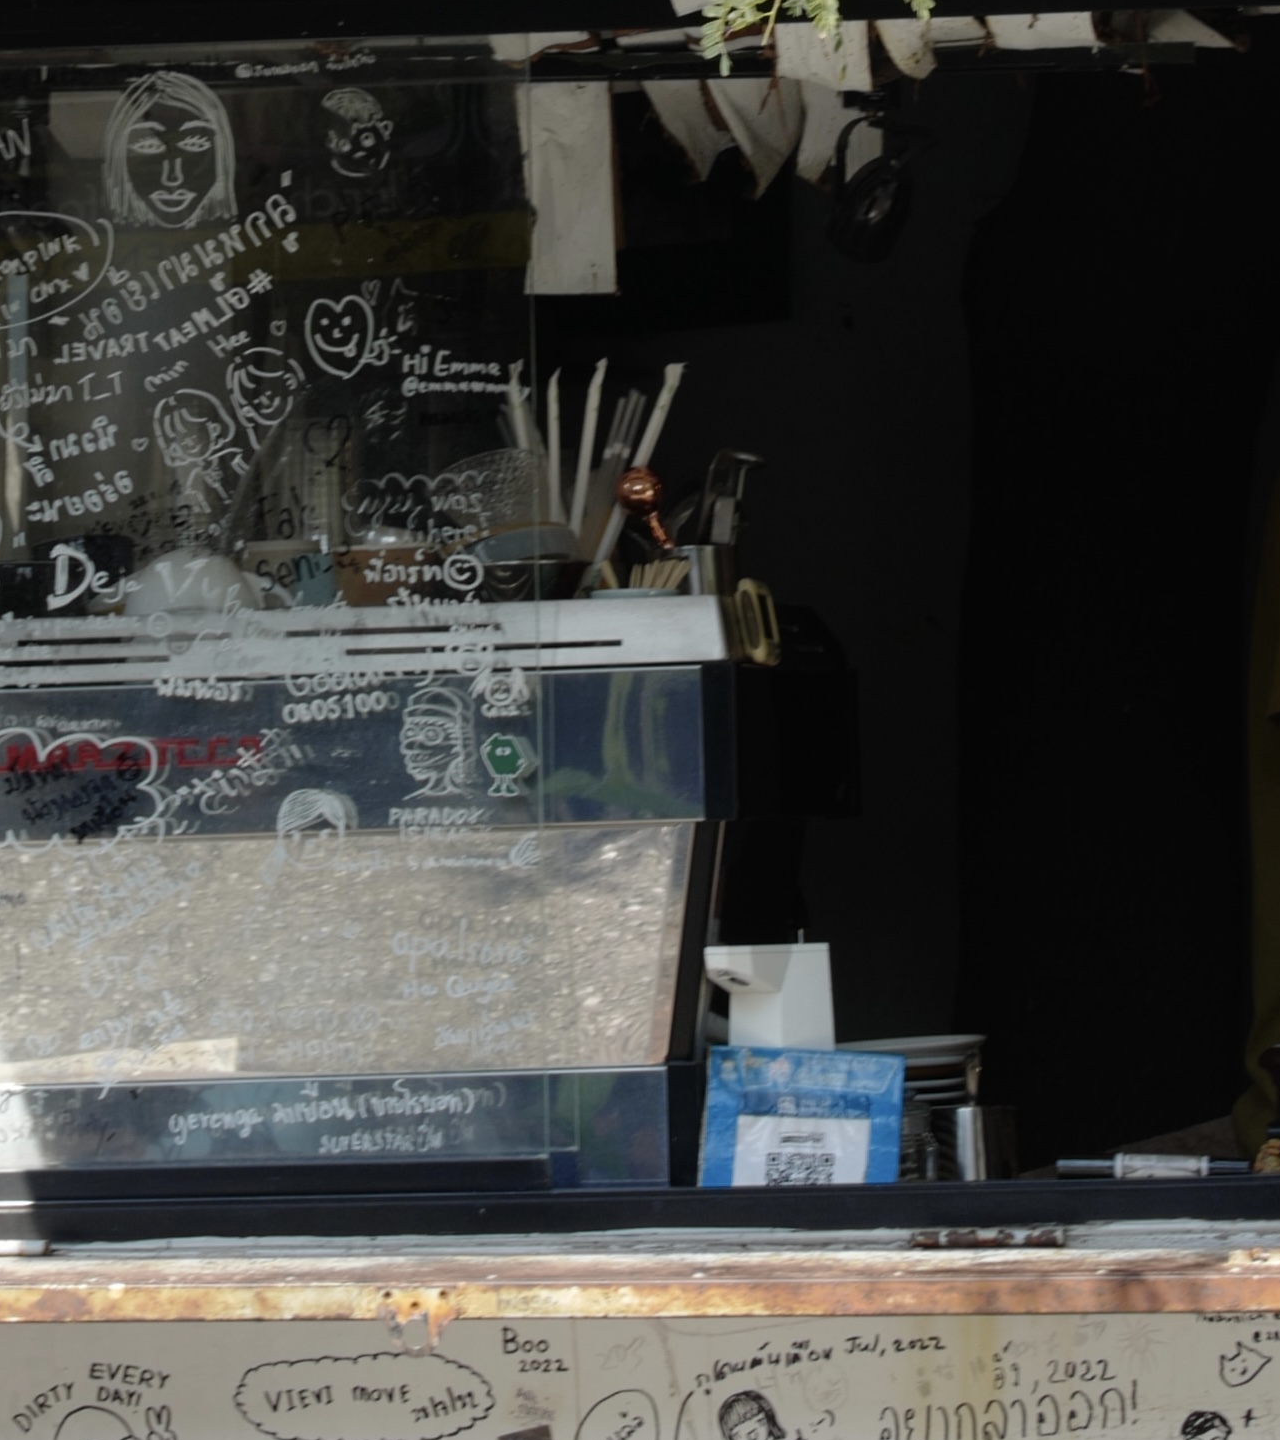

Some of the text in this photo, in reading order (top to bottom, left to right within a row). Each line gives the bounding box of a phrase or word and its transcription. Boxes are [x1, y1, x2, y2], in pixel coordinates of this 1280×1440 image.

[402, 344, 432, 375] Hi
[431, 492, 483, 513] was
[502, 1325, 551, 1357] Boo
[894, 1337, 948, 1352] 2022
[88, 1361, 172, 1390] EVERY
[517, 1357, 570, 1374] 2022
[1047, 1358, 1118, 1384] 2022
[11, 1382, 75, 1434] DIRTY
[95, 1385, 143, 1415] DAY!
